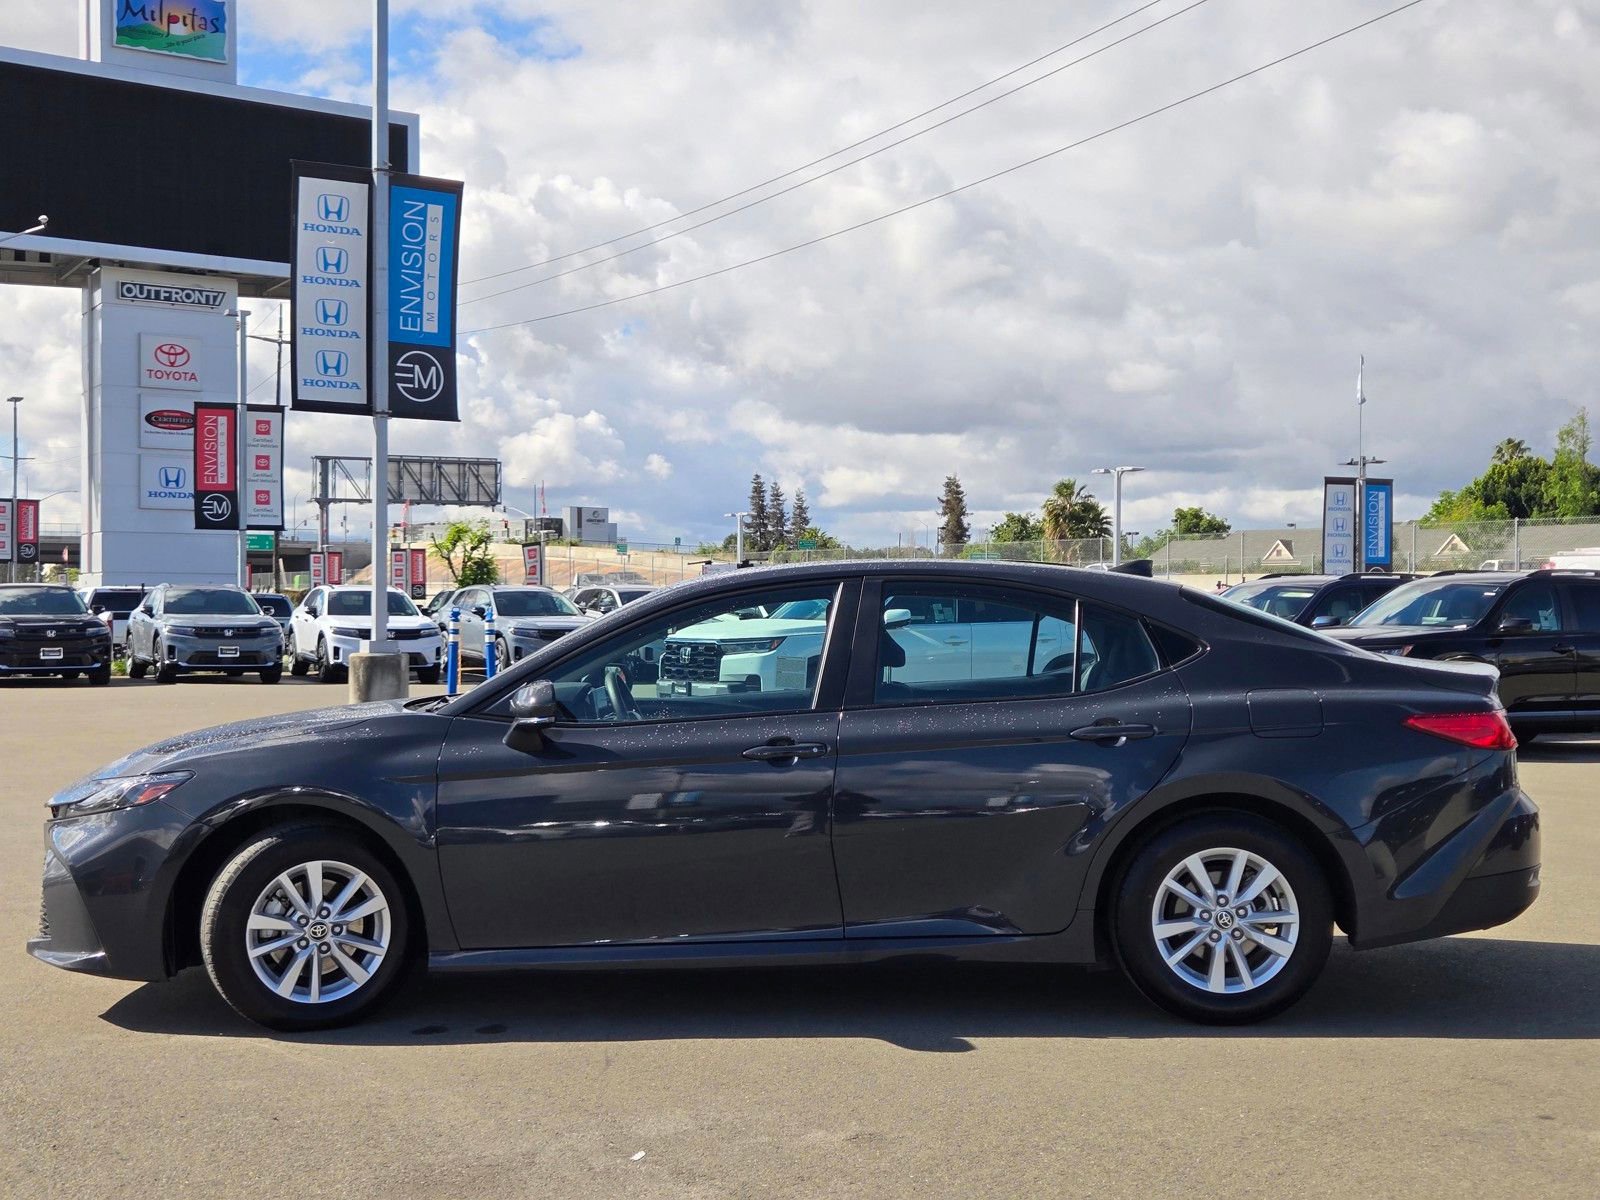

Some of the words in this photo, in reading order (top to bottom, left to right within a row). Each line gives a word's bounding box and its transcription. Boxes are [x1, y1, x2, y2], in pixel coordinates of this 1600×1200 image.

[119, 0, 219, 37] Milpitas
[303, 222, 362, 236] HONDA
[400, 200, 426, 332] ENVISION
[426, 216, 439, 322] MOTORS
[302, 275, 361, 288] HONDA
[302, 327, 361, 339] HONDA
[146, 369, 198, 382] TOYOTA
[302, 378, 361, 390] HONDA
[204, 415, 217, 484] ENVISION
[148, 491, 194, 499] HONDA
[1368, 491, 1378, 557] ENVISION
